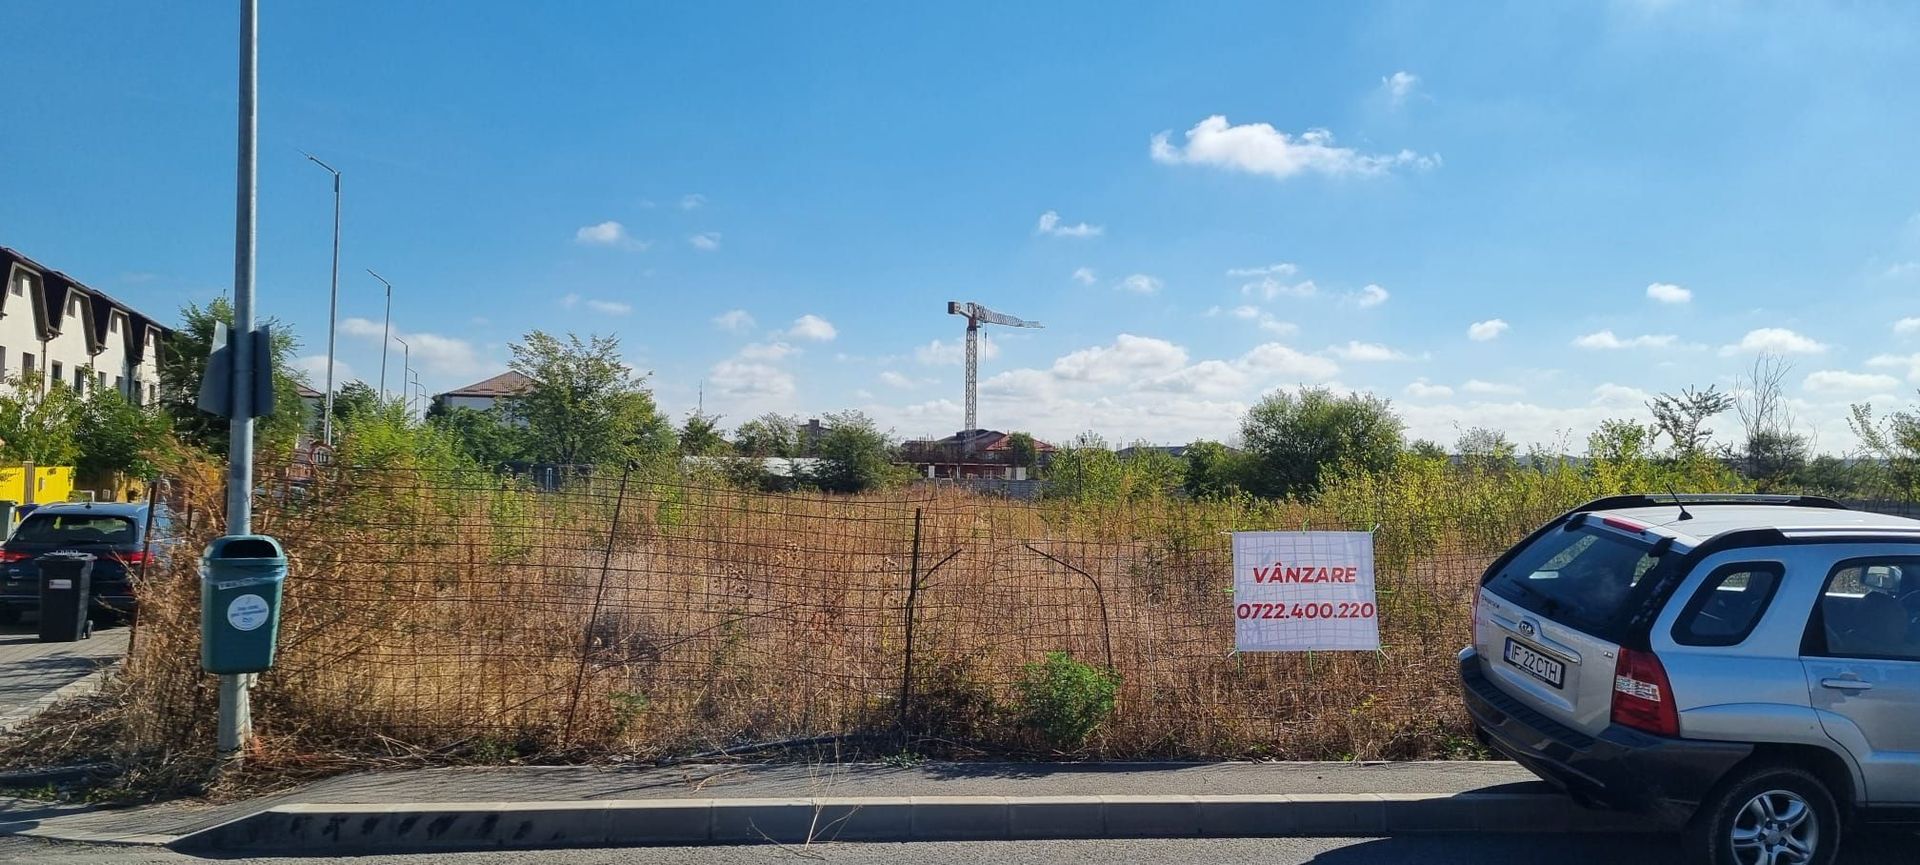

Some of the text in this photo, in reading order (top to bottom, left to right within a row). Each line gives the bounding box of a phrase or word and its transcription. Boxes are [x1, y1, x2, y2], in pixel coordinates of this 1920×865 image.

[1253, 562, 1357, 584] VÂNZARE
[1236, 602, 1374, 620] 0722.400.220
[1510, 644, 1522, 660] IF
